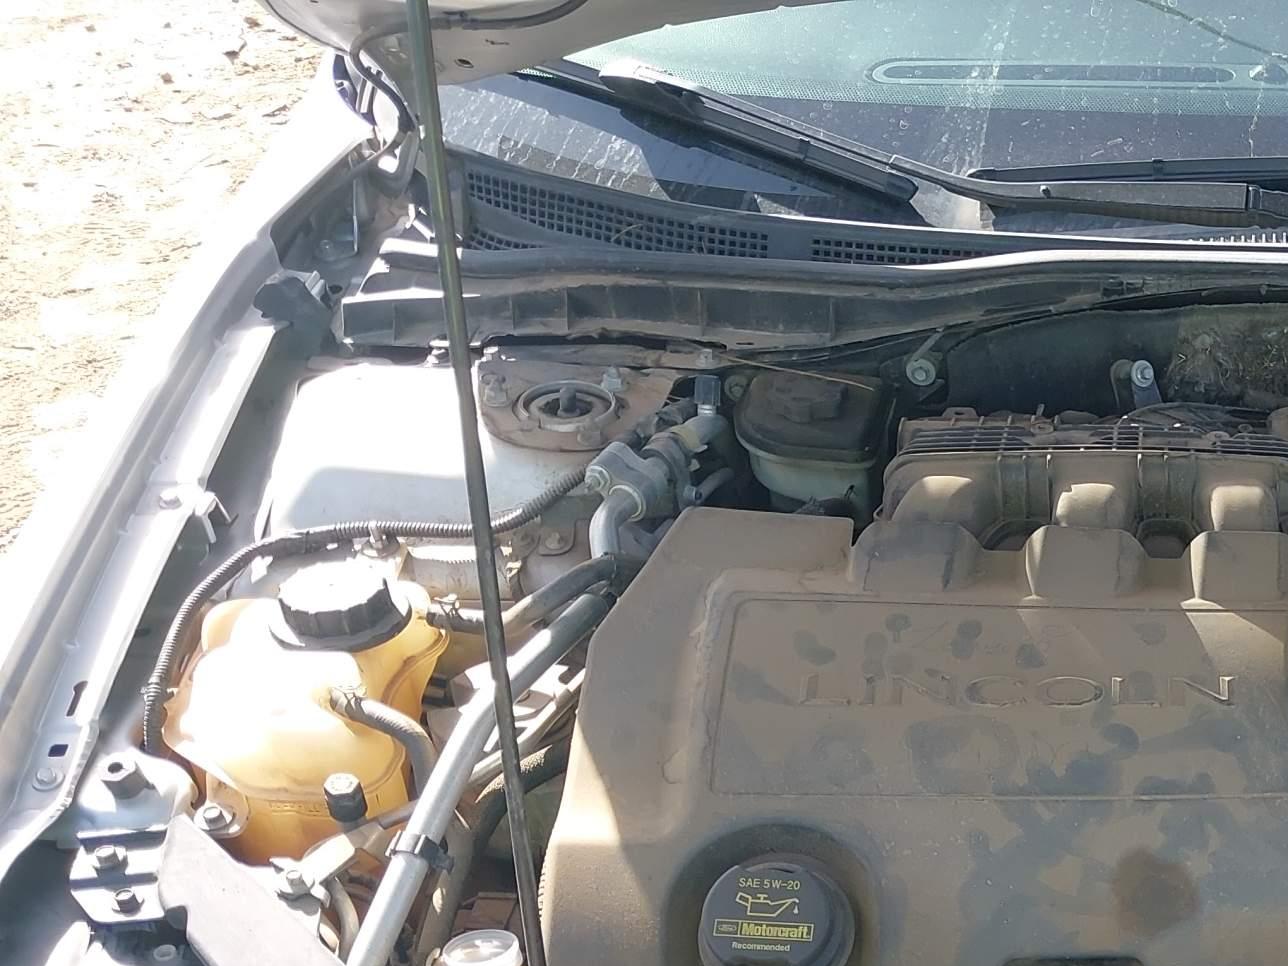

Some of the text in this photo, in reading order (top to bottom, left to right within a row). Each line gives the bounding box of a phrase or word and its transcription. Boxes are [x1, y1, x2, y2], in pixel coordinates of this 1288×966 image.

[799, 675, 1236, 707] LINCOLN
[738, 878, 800, 890] SAE 5W-20
[741, 922, 808, 939] Motorcraft
[731, 941, 790, 951] Recommended
